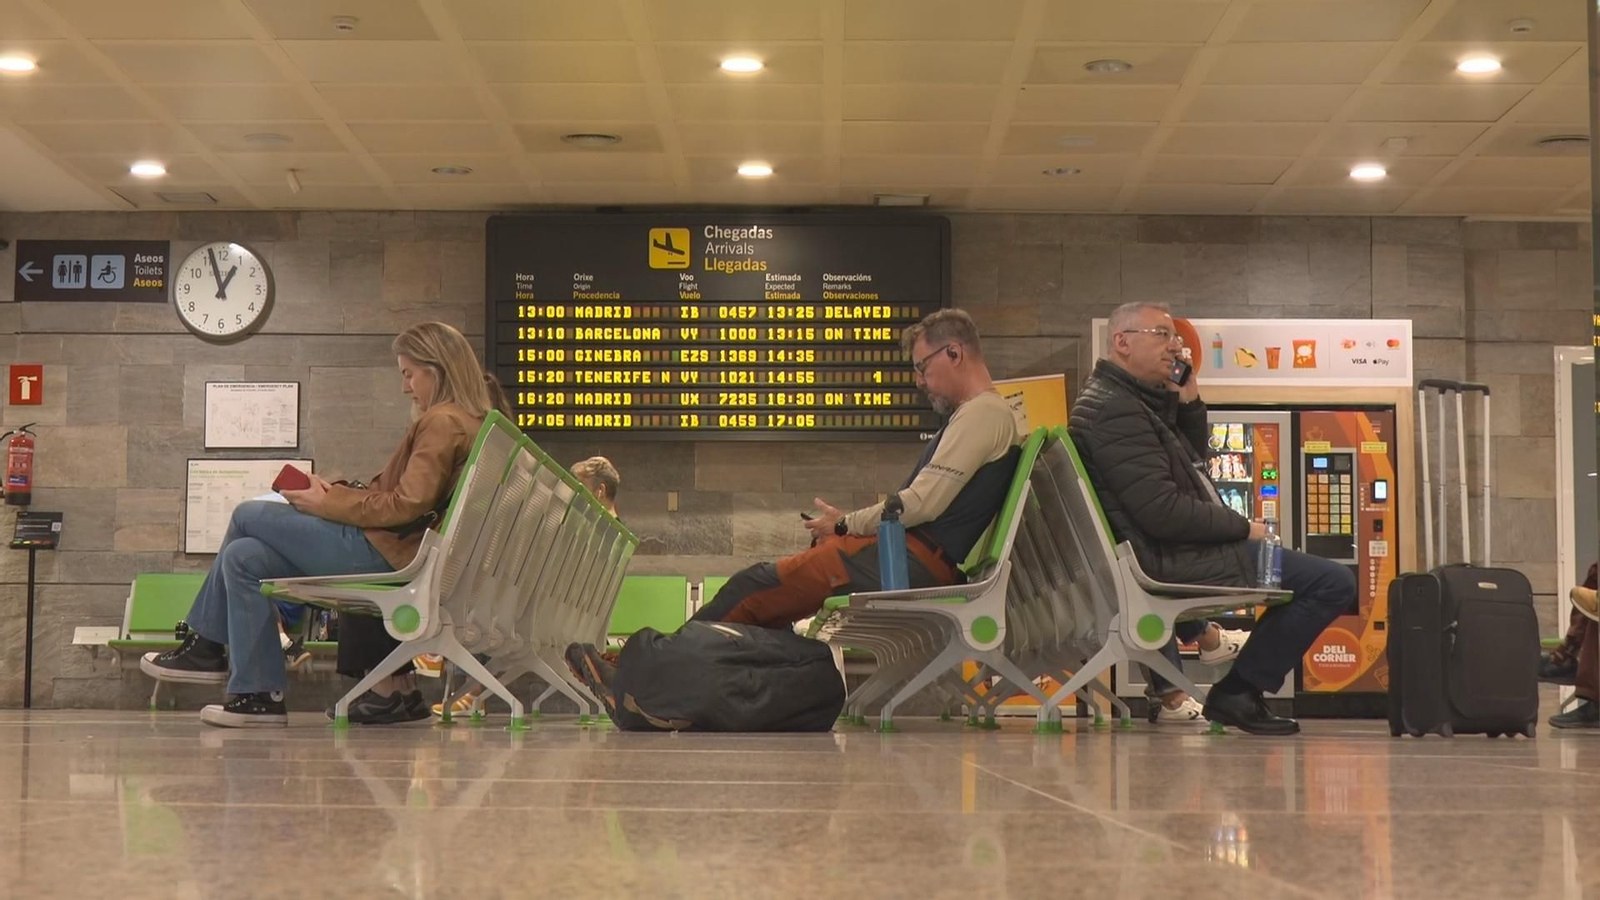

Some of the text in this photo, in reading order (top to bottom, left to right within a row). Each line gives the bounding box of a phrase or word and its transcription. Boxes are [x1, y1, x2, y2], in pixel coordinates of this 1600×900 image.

[704, 225, 773, 241] Chegadas
[704, 242, 754, 255] Arrivals
[134, 253, 164, 263] Aseos
[218, 250, 229, 261] 12
[238, 255, 242, 265] 1
[134, 265, 163, 276] Toilets
[704, 257, 767, 273] Llegadas
[190, 268, 202, 278] 10
[249, 267, 256, 277] 2
[515, 273, 872, 282] Hora Orixe Voo Estimada Observacións
[133, 278, 163, 287] Aseos
[516, 282, 852, 292] Time Origin Flight Expected Remarks
[183, 283, 191, 294] 9
[255, 284, 262, 295] 3
[515, 291, 879, 300] Hora Procedencia Vuelo Estimada Observaciones
[188, 301, 195, 312] 8
[247, 302, 255, 312] 4
[518, 306, 891, 319] 13:00 MADRID IB 0457 13:25 DELAYED
[202, 313, 209, 324] 7
[217, 318, 225, 329] 6
[235, 314, 242, 325] 5
[518, 327, 891, 340] 13:10 BARCELONA VY 1000 13:15 ON TIME
[518, 349, 815, 362] 15:00 GINEBRA EZS 1369 14:35
[518, 371, 565, 384] 15:20
[574, 371, 651, 384] TENERIFE
[661, 371, 671, 384] N
[680, 371, 699, 384] VY
[719, 371, 757, 384] 1021
[767, 371, 815, 384] 14:55
[518, 392, 891, 405] 16:20 MADRID UX 7235 16:30 ON TIME
[518, 414, 815, 427] 17:05 MADRID IB 0459 17:05
[1323, 645, 1346, 654] DELI
[1313, 654, 1356, 663] CORNER
